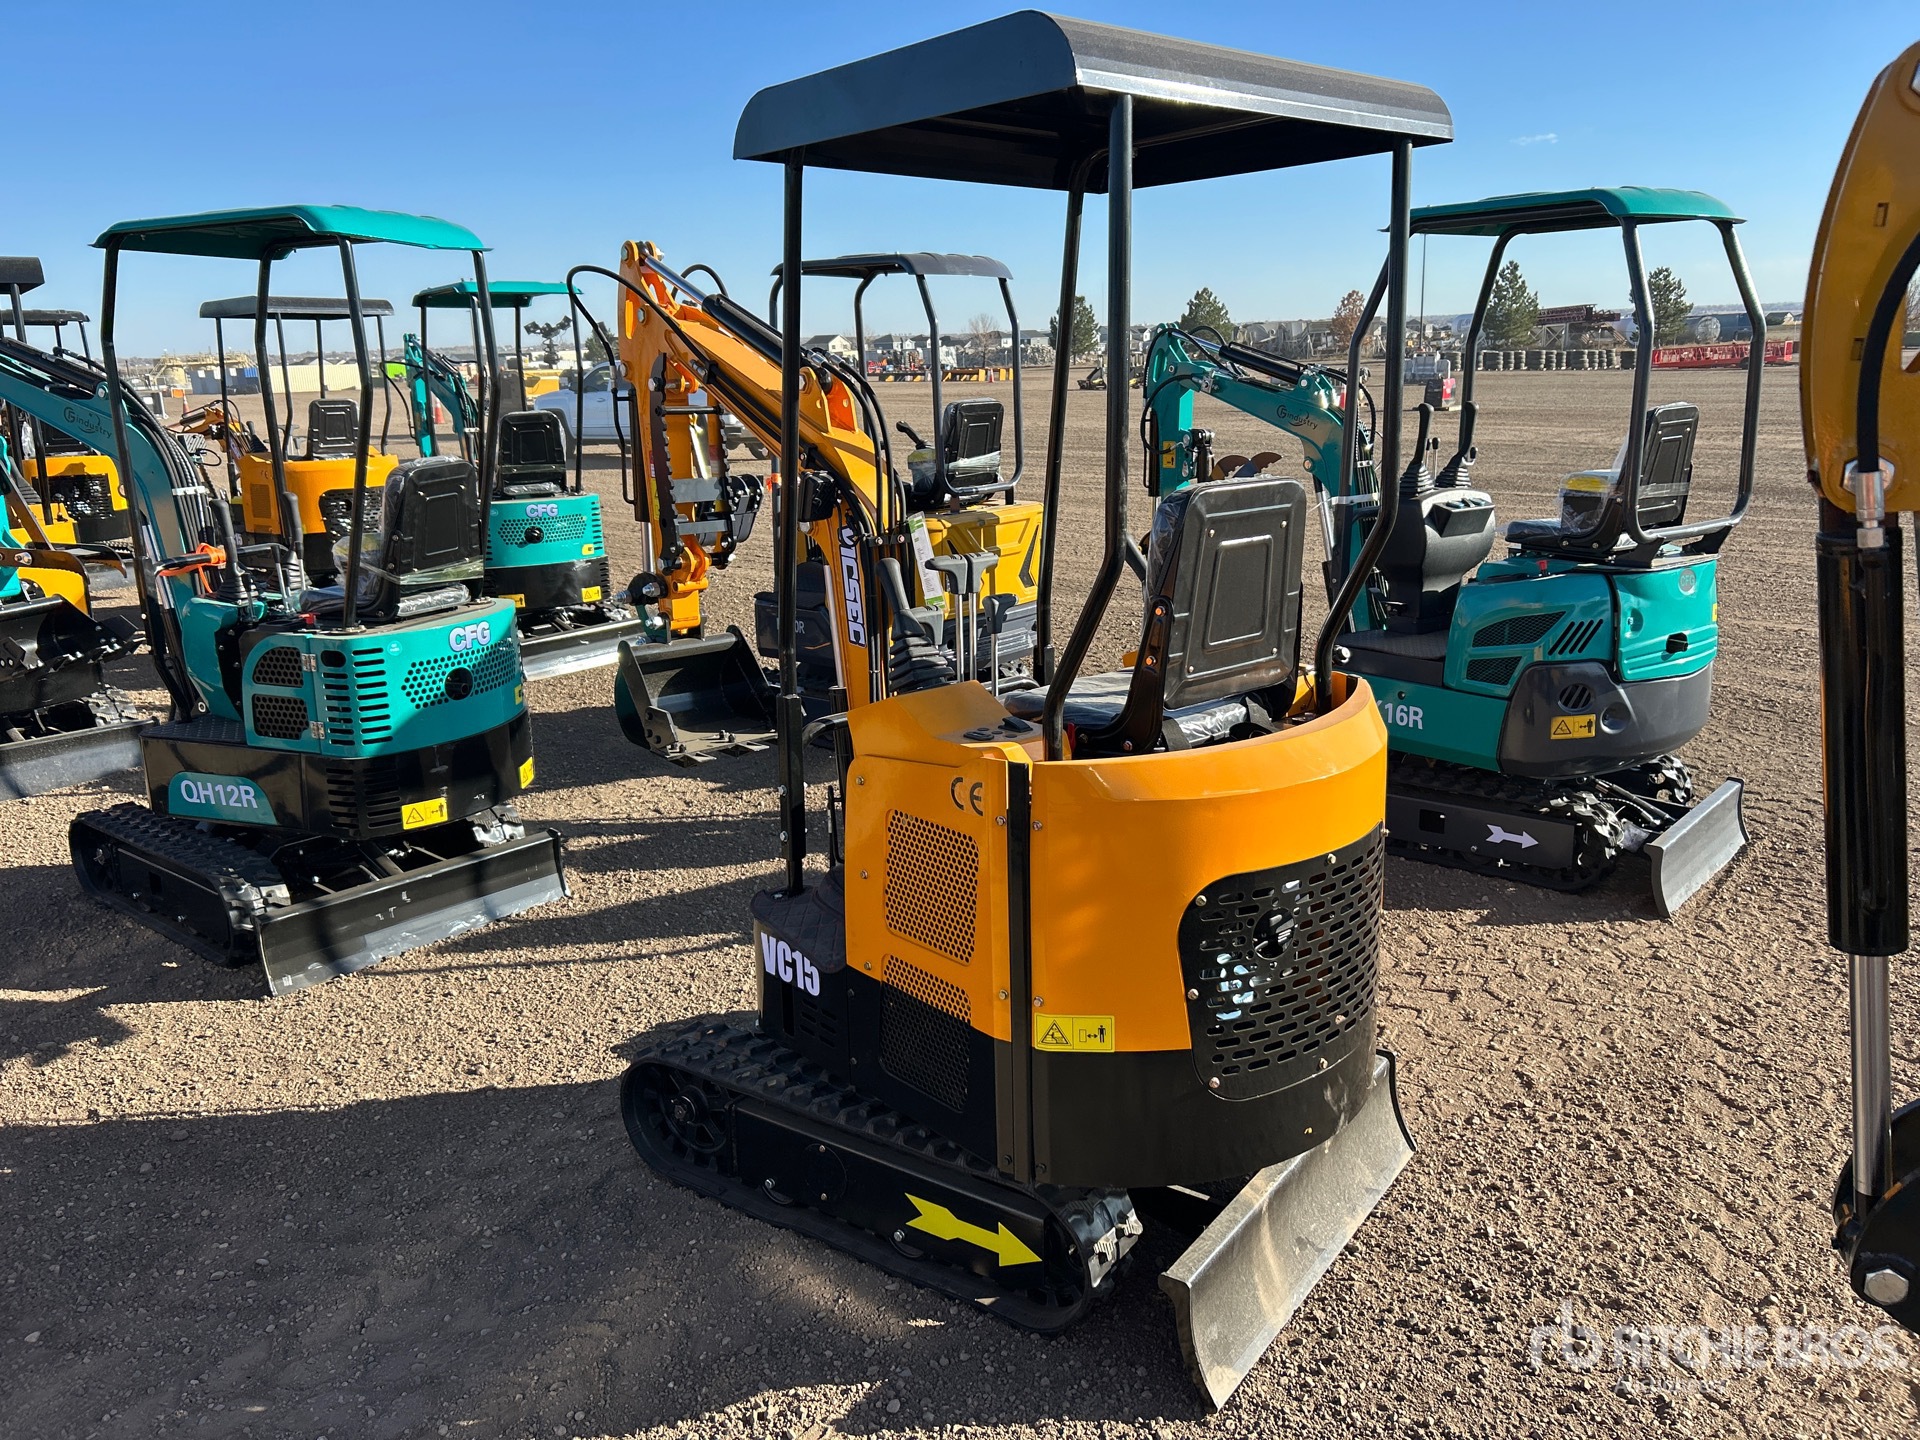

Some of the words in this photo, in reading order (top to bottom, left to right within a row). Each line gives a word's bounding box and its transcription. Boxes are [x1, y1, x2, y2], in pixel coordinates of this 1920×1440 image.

[526, 504, 558, 518] CFG
[449, 621, 491, 652] CFG
[1376, 700, 1424, 730] 16R
[180, 779, 258, 808] QH12R
[950, 776, 983, 817] CE
[760, 931, 820, 996] VC15
